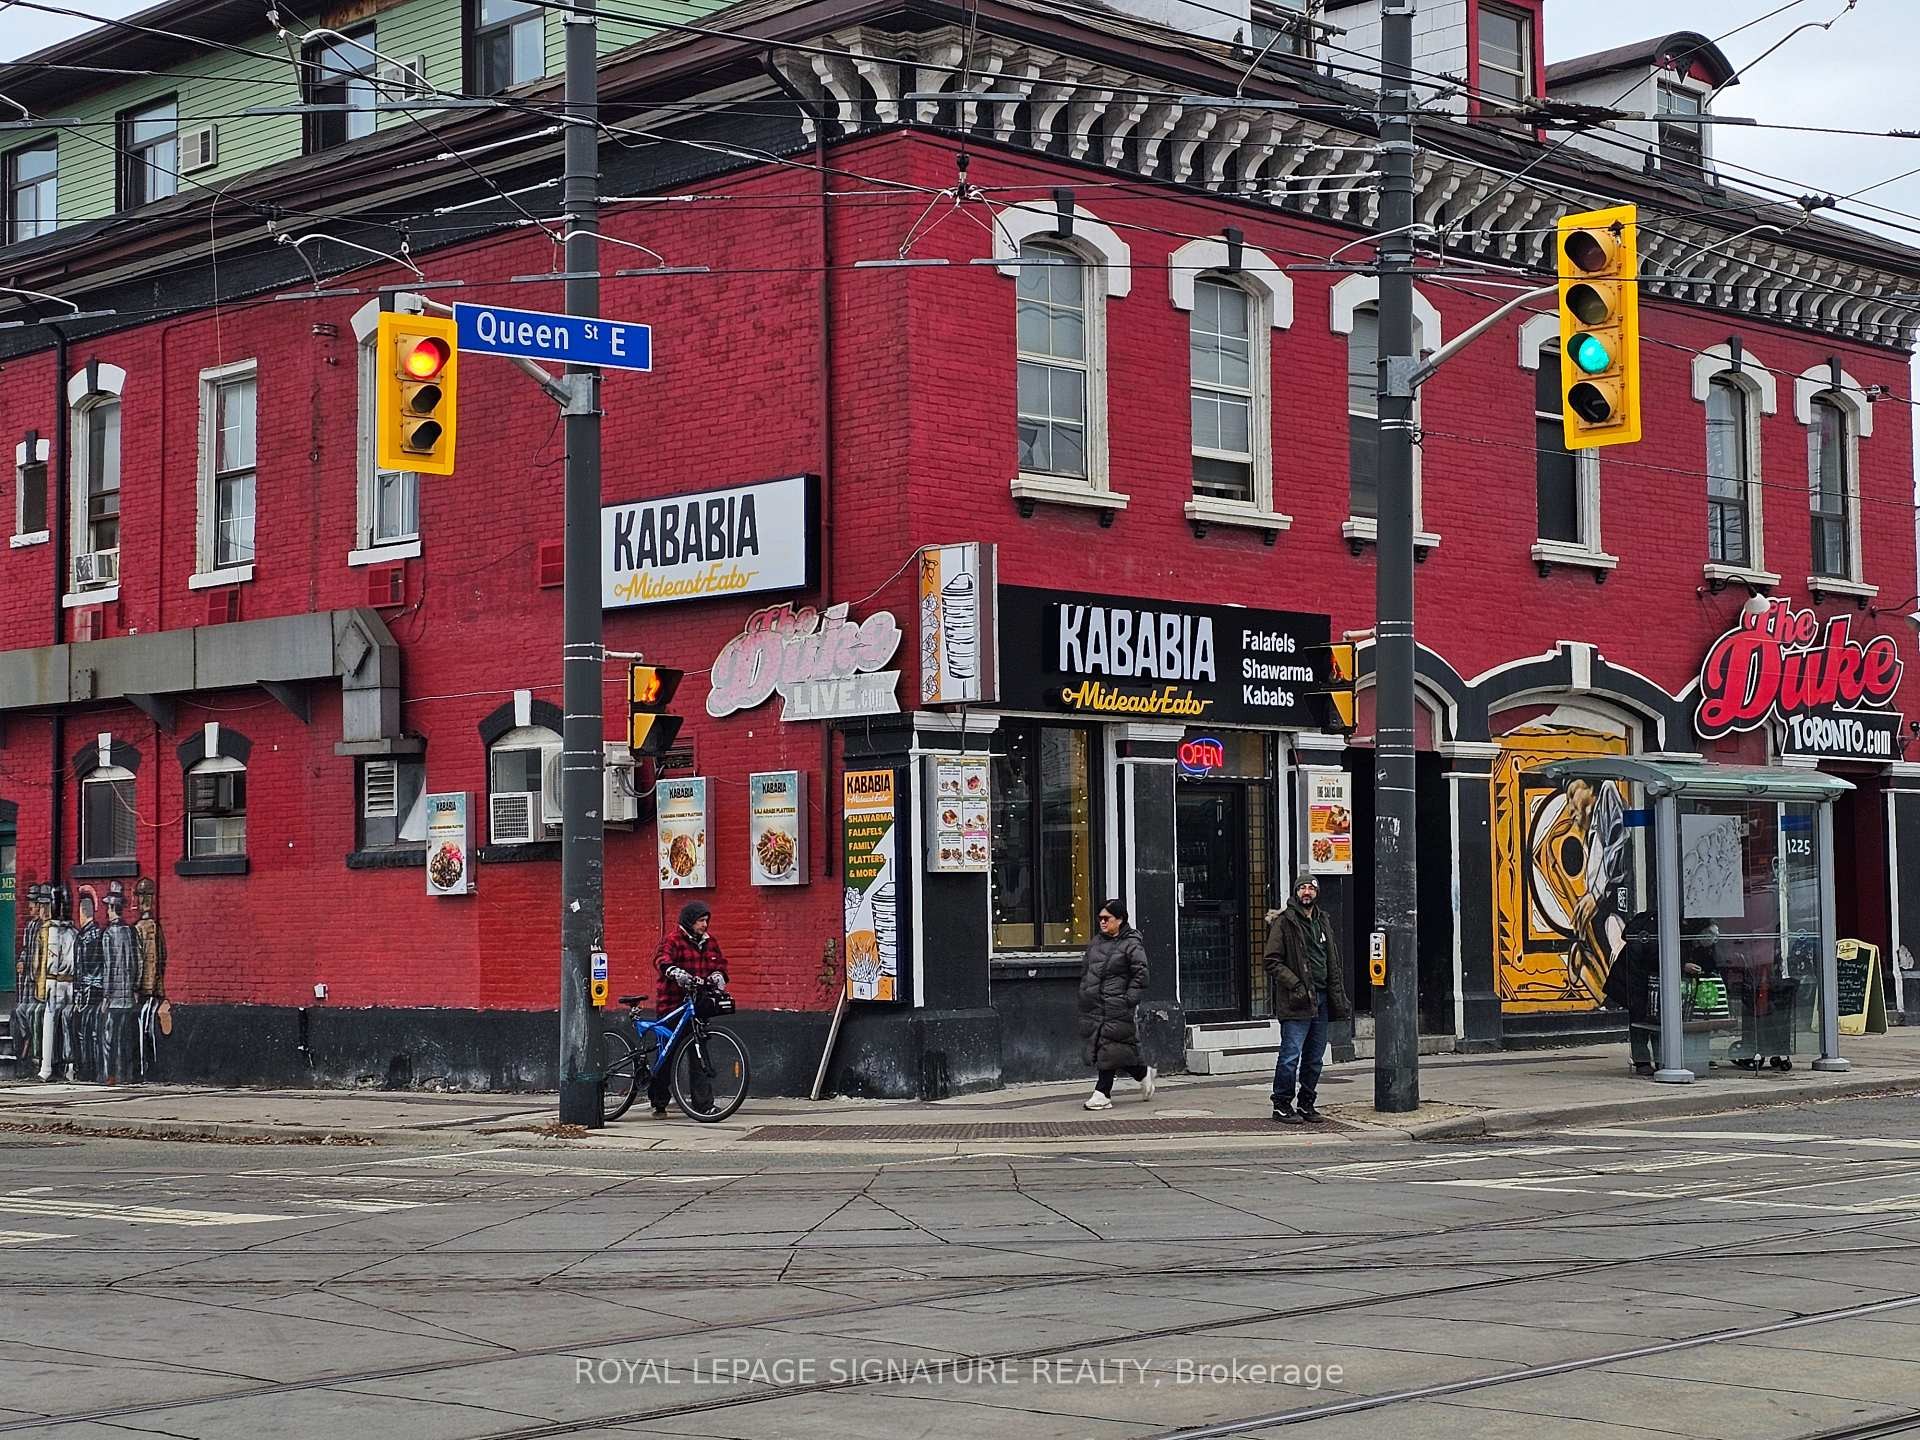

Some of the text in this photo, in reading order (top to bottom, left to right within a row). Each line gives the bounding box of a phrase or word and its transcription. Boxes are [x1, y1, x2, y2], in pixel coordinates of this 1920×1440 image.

[477, 311, 626, 357] Queen St E
[614, 494, 759, 571] KABABIA
[1744, 601, 1816, 642] The
[1059, 604, 1216, 682] KABABIA
[1242, 629, 1296, 653] Falafels
[1242, 658, 1314, 682] Shawarma
[1702, 621, 1900, 727] Duke
[1075, 680, 1204, 715] Mideast Eats
[1242, 684, 1295, 707] Kababs
[1789, 713, 1891, 755] TORONTO.com
[1180, 740, 1223, 768] OPEN
[846, 773, 891, 794] KABABIA
[848, 841, 876, 851] FAMILY
[1787, 838, 1811, 856] 1225
